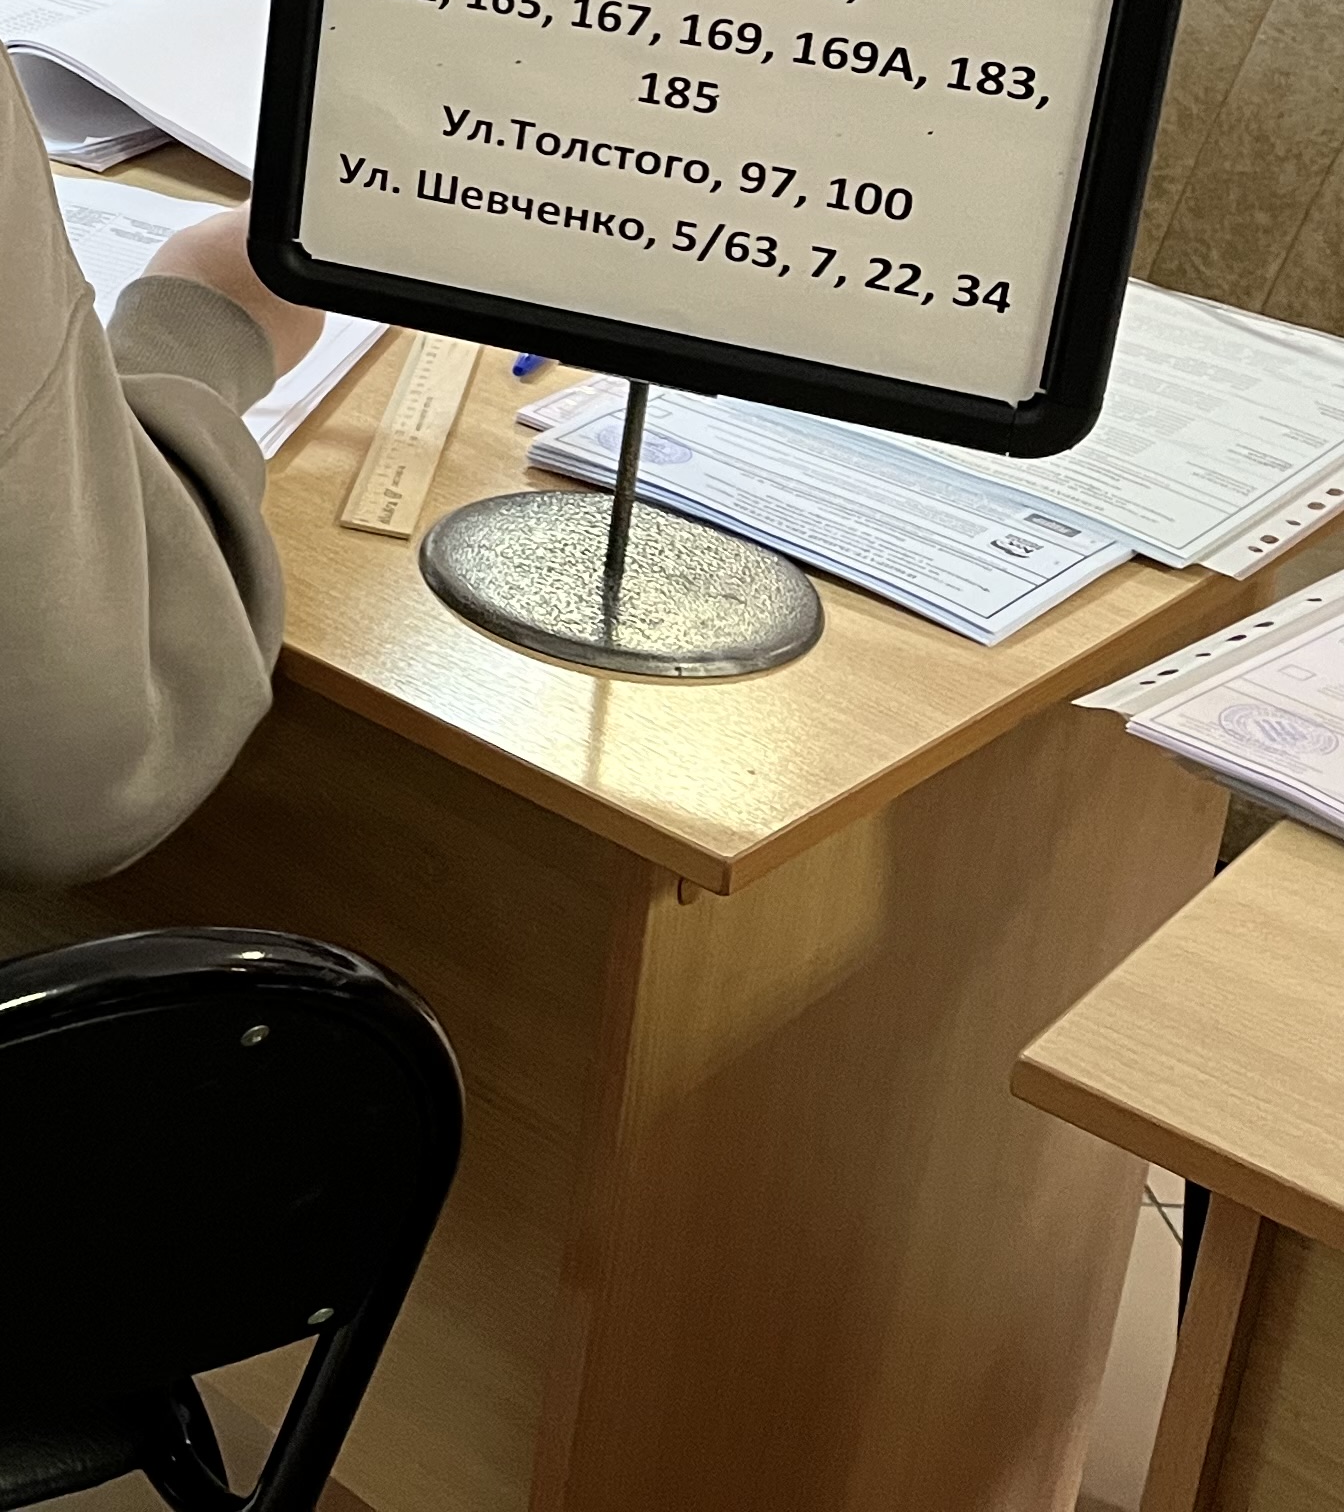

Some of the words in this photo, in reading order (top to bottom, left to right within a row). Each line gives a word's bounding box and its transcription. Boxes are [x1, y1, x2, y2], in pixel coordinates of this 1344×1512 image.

[638, 72, 720, 114] 185
[679, 14, 774, 65] 169,
[792, 32, 927, 91] 169А,
[946, 57, 1050, 111] 183,
[442, 105, 722, 195] Ул.Толстого,
[739, 162, 807, 210] 97,
[826, 178, 913, 221] 100
[339, 153, 402, 196] Ул.
[416, 169, 656, 251] Шевченко,
[672, 220, 791, 279] 5/63,
[811, 245, 847, 290] 7,
[864, 257, 934, 307] 22,
[952, 274, 1012, 315] 34
